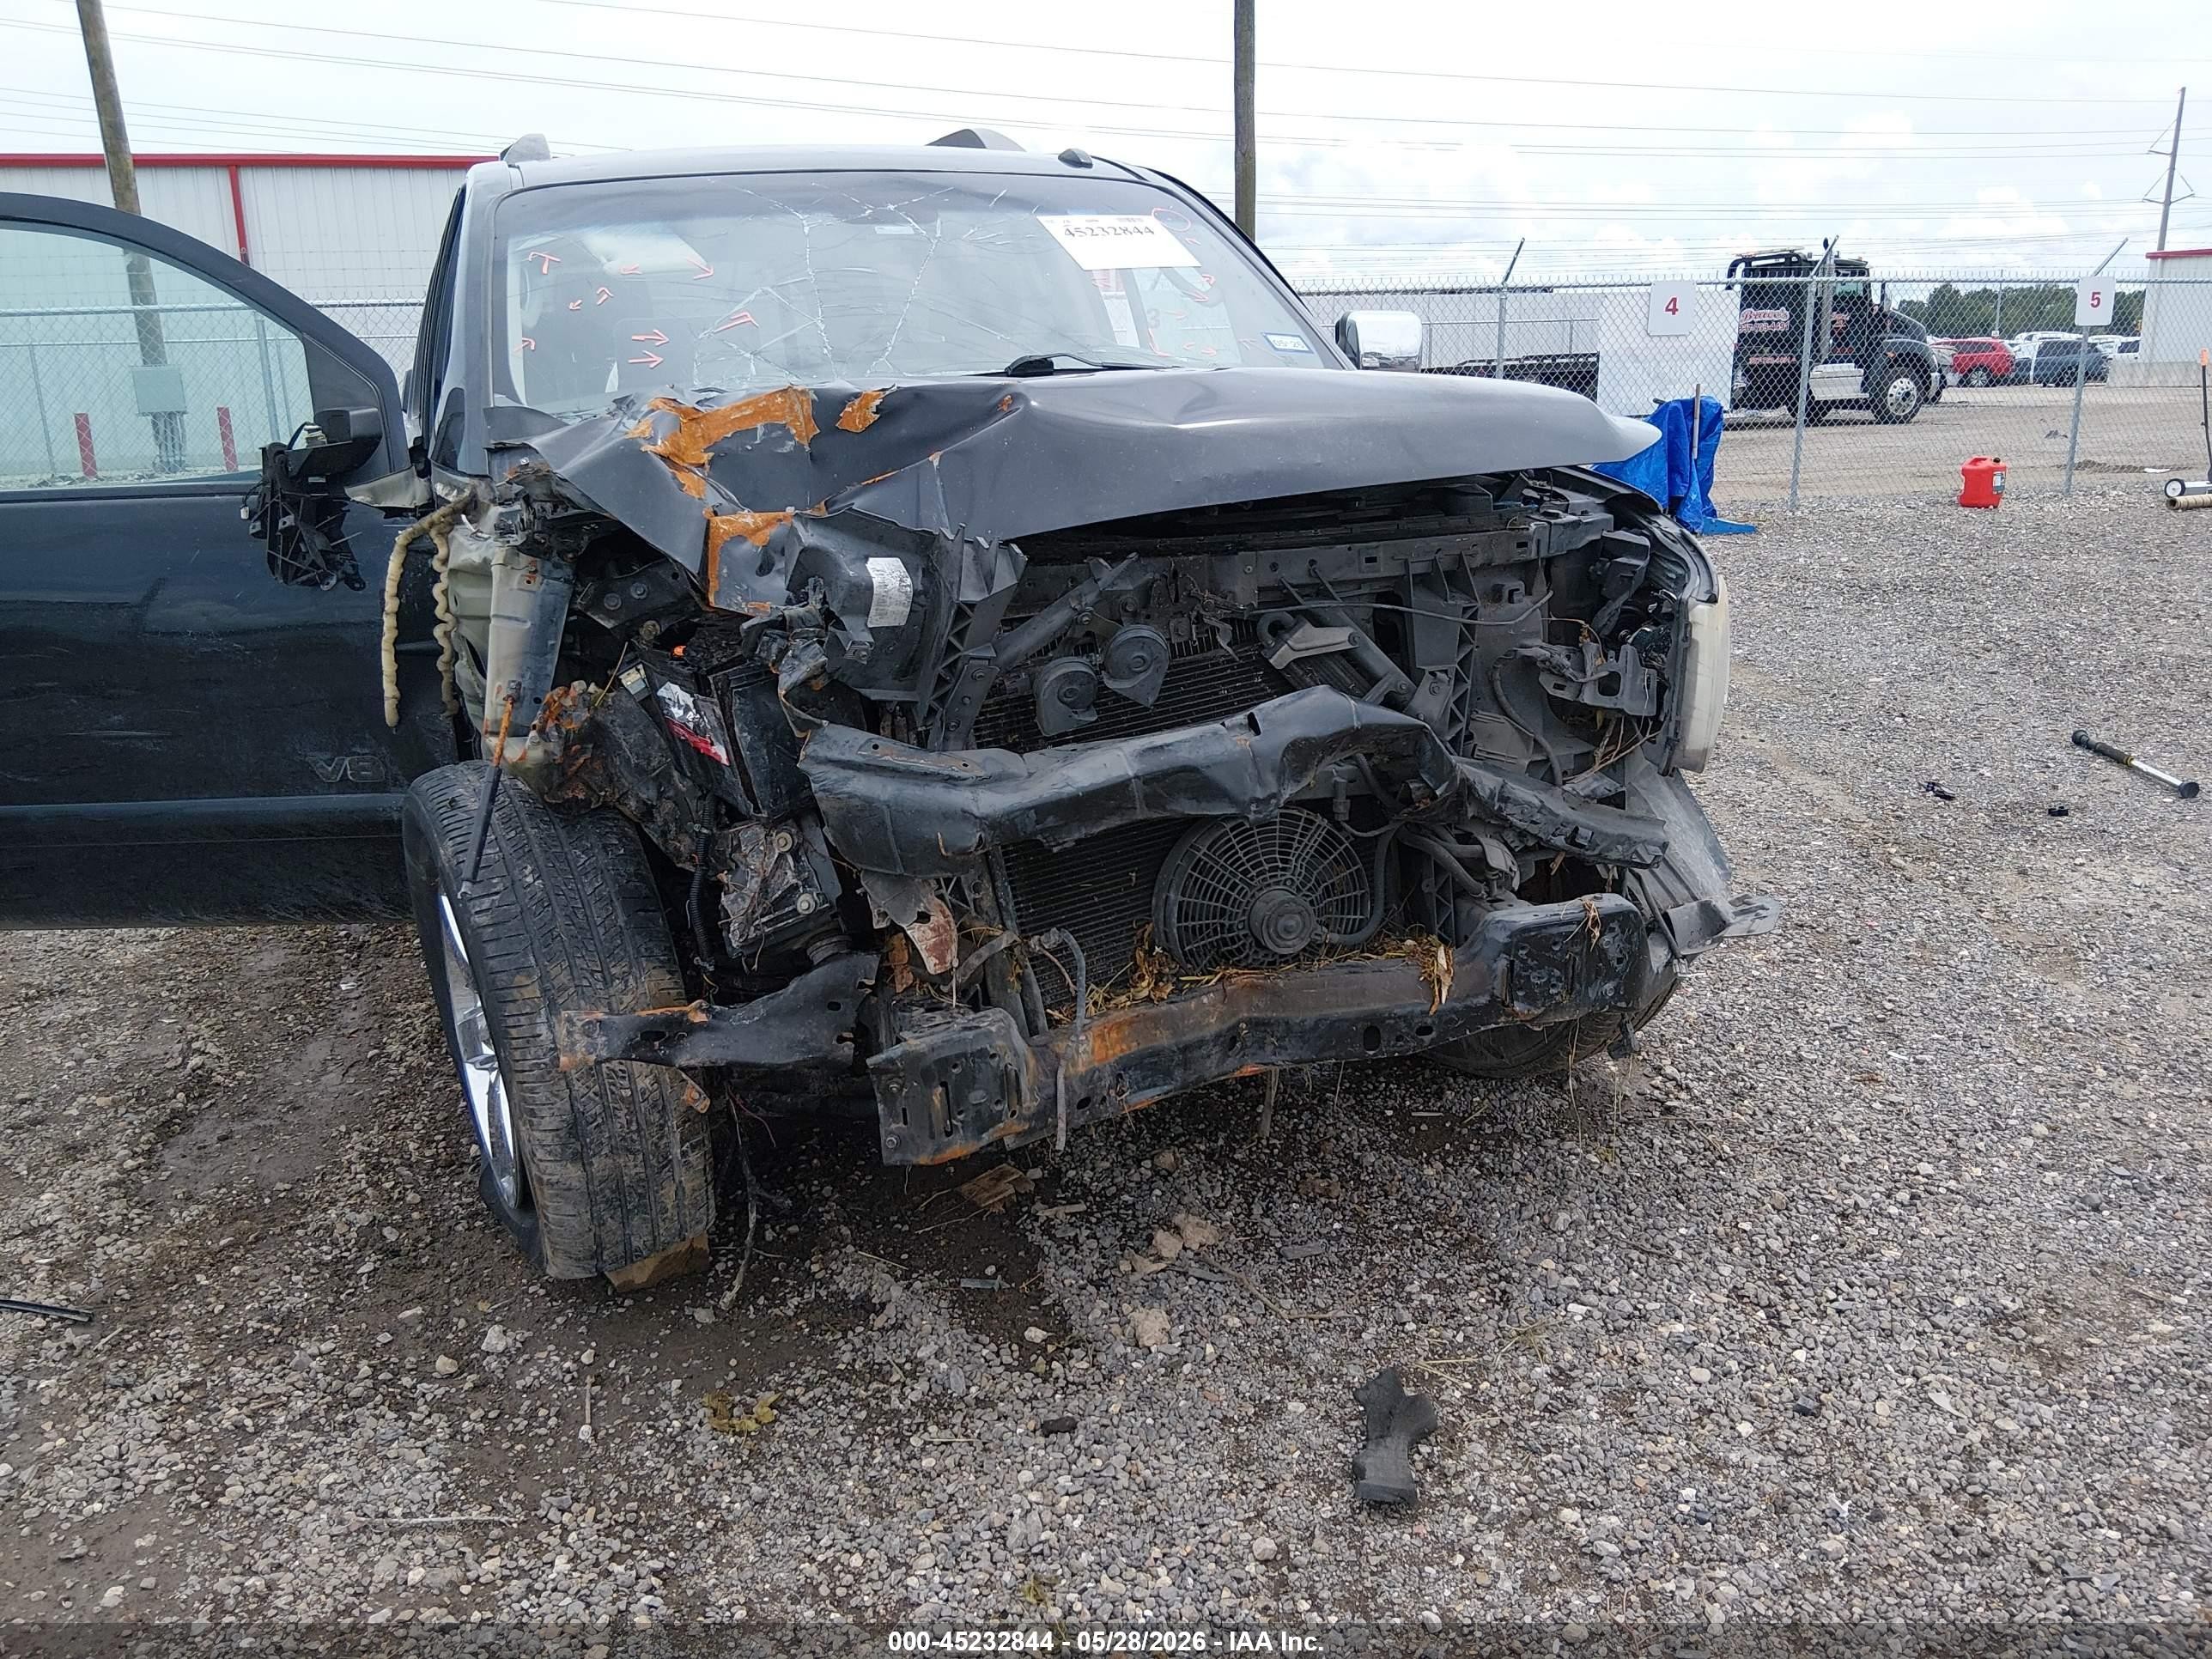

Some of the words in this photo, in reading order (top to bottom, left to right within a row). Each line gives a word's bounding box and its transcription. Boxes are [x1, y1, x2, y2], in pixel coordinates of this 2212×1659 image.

[1064, 226, 1155, 238] 45232844
[1664, 297, 1679, 315] 4
[2090, 291, 2101, 308] 5
